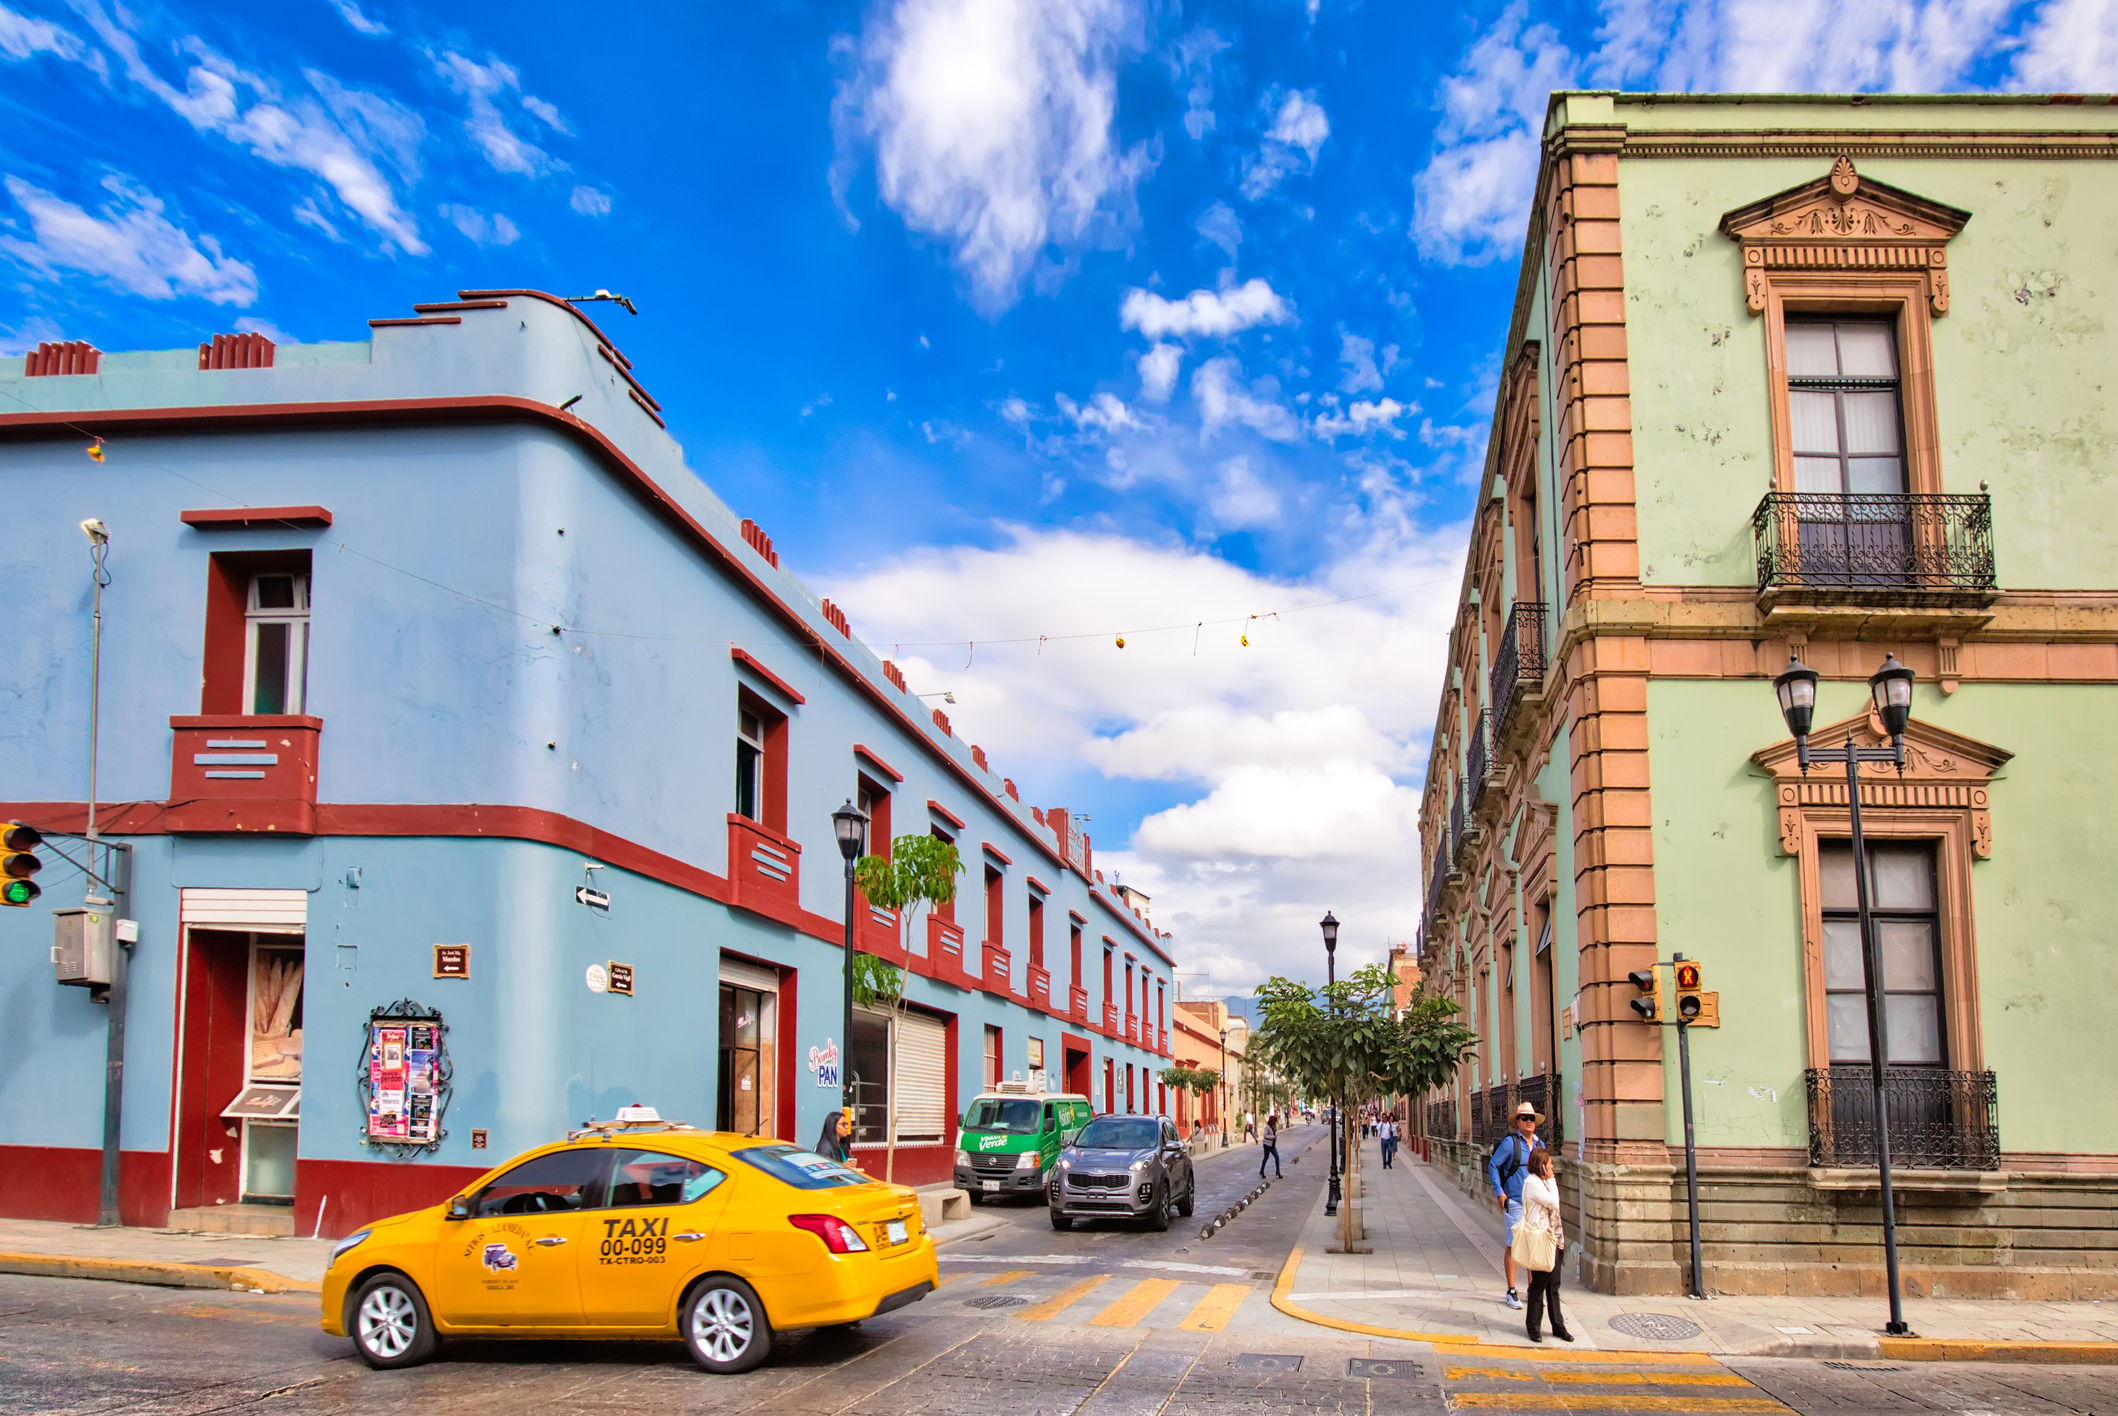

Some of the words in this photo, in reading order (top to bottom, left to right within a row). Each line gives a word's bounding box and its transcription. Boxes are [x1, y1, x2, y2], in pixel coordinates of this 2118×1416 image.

[818, 1064, 838, 1086] PAN
[979, 1138, 1008, 1151] Verde
[603, 1217, 669, 1238] TAXI
[600, 1237, 666, 1256] 00-099
